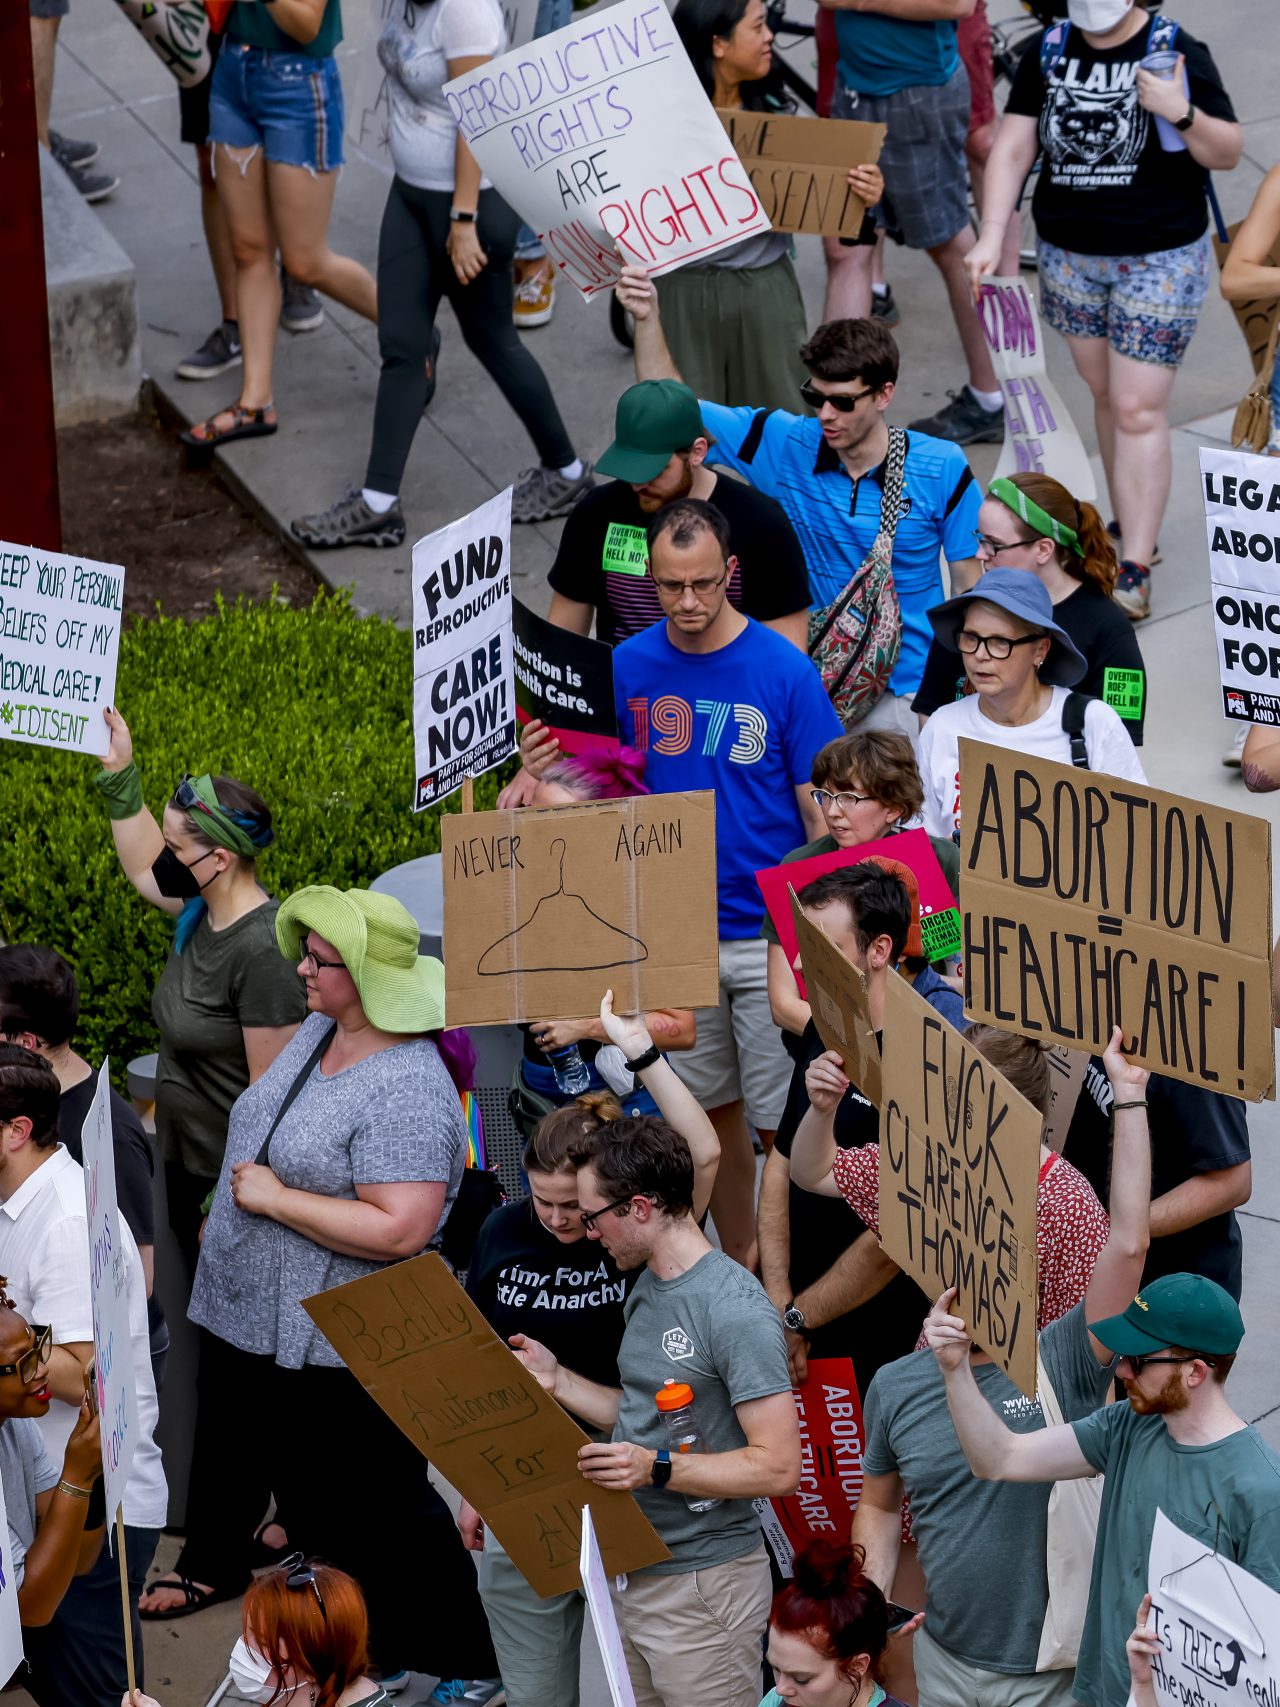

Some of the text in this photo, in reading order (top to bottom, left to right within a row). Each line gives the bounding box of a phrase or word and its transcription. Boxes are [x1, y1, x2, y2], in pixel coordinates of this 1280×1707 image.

[444, 6, 674, 139] REPRODUCTIVE
[511, 84, 632, 168] RIGHTS
[729, 118, 777, 156] WE
[556, 150, 621, 210] ARE
[1072, 175, 1132, 185] SUPREMACY
[599, 157, 759, 262] RIGHTS
[605, 547, 645, 563] HELL NO!
[608, 536, 628, 547] ROE?
[0, 553, 122, 612] EEP YOUR PERSONAL
[422, 536, 503, 621] FUND
[415, 574, 511, 650] REPRODUCTIVE
[56, 619, 88, 651] OFF
[90, 624, 114, 656] MY
[53, 668, 102, 702] CARE!
[431, 633, 501, 715] CARE
[566, 665, 582, 688] is
[1107, 682, 1127, 692] ROE?
[1108, 671, 1140, 683] OVERTURN
[545, 682, 594, 716] Care.
[1106, 694, 1127, 706] HELL
[1228, 698, 1249, 716] PSL
[1253, 709, 1274, 724] AND
[428, 679, 507, 769] NOW!
[627, 695, 768, 765] 1973
[438, 727, 506, 781] PARTY FOR SOCIALISM
[419, 782, 436, 803] PSL
[437, 779, 451, 798] AND
[453, 819, 682, 880] NEVER AGAIN
[968, 763, 1233, 944] ABORTION
[931, 927, 961, 943] FEMALE
[921, 1016, 1014, 1205] FUCK
[886, 1099, 1015, 1286] CLARENCE
[532, 1279, 626, 1310] Anarchy
[555, 1267, 595, 1286] For
[897, 1191, 1022, 1371] THOMAS!
[332, 1272, 473, 1363] Bodily
[668, 1333, 688, 1344] LETR
[401, 1376, 540, 1441] Autonomy
[479, 1446, 545, 1487] For
[1178, 1617, 1224, 1680] THIS
[1151, 1652, 1178, 1699] the
